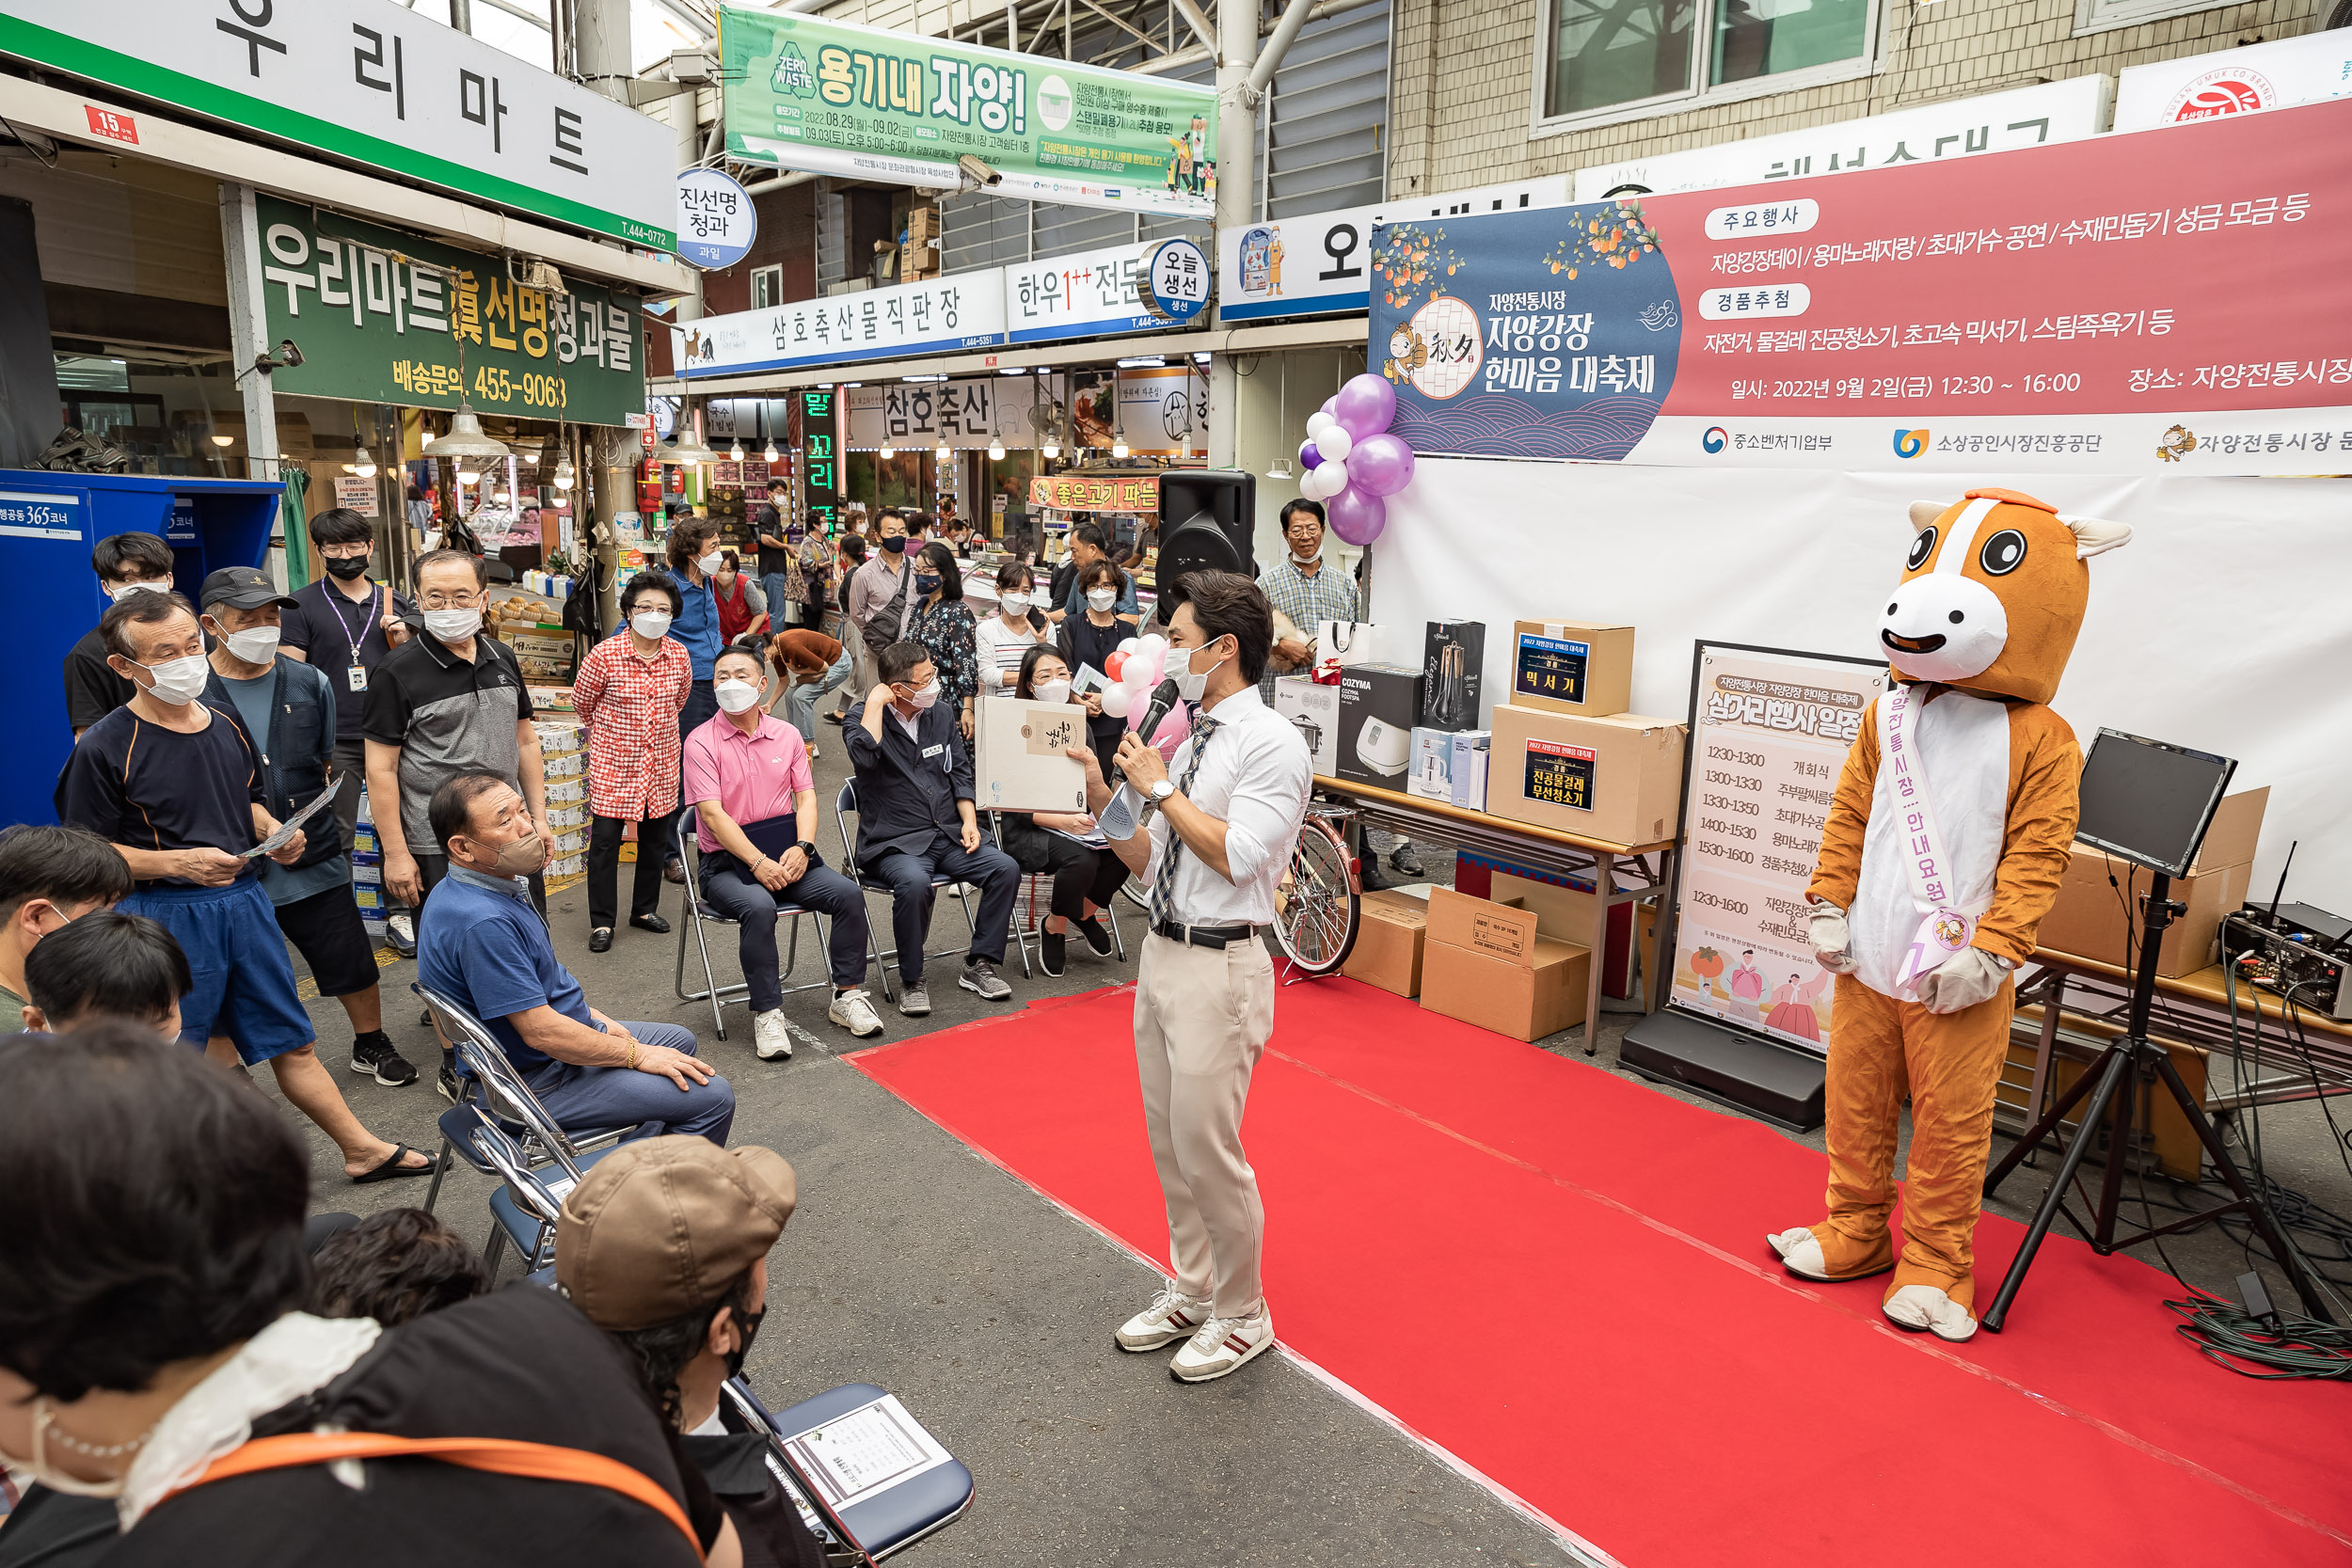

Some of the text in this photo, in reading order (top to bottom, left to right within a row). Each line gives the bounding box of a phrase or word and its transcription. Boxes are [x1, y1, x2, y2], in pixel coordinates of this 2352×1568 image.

[779, 56, 807, 73] ZERO
[216, 0, 590, 176] 우리마트
[775, 70, 813, 88] WASTE
[819, 48, 1025, 133] 용기내 자양!
[1076, 83, 1132, 101] 자양전통시장에서
[1076, 96, 1093, 108] 5만원
[1095, 98, 1110, 110] 이상
[2166, 87, 2192, 117] BUSAN
[2198, 71, 2227, 87] UMUK
[98, 112, 119, 132] 15
[776, 105, 800, 119] 응모기간
[942, 130, 988, 148] 자양전통시장
[989, 135, 1018, 150] 고객쉼터
[1020, 141, 1030, 152] 1층
[1157, 122, 1174, 135] 응모!
[805, 128, 845, 145] 09.03(토)
[847, 134, 865, 149] 오후
[867, 135, 908, 153] 5:00~6:00
[852, 158, 886, 169] 자양전통시장
[679, 187, 737, 214] 진선명
[622, 220, 666, 246] T.444-0772
[690, 214, 729, 237] 청과
[1710, 245, 1803, 275] 자양강장데이
[1813, 235, 1916, 268] 용마노래자랑
[1926, 228, 2004, 257] 초대가수
[2006, 222, 2048, 252] 공연
[2060, 209, 2169, 245] 수재민돕기
[2173, 203, 2223, 234] 성금
[2224, 198, 2279, 228] 모금
[2280, 192, 2312, 222] 등
[698, 246, 721, 261] 과일
[1165, 251, 1199, 275] 오늘
[1165, 274, 1197, 297] 생선
[1170, 300, 1188, 312] 생선
[1488, 291, 1567, 312] 자양전통시장
[772, 286, 961, 351] 삼호축산물직판장
[961, 335, 993, 348] T.444-5351
[1486, 312, 1595, 352] 자양강장
[1704, 309, 2175, 355] 자전거, 물걸레 진공청소기, 초고속 믹서기, 스팀족욕기 등
[1485, 354, 1655, 393] 한마음 대축제
[1731, 379, 1767, 401] 일시:
[1772, 378, 1831, 399] 2022년
[1836, 378, 1865, 399] 9월
[1869, 376, 1933, 399] 2일(금)
[1942, 376, 1994, 395] 12:30
[2023, 372, 2081, 393] 16:00
[2128, 368, 2183, 393] 장소:
[2191, 358, 2352, 389] 자양전통시장
[475, 365, 566, 408] 455-9063
[1735, 434, 1833, 451] 중소벤처기업부
[1936, 435, 2102, 453] 소상공인시장진흥공단
[2200, 431, 2333, 453] 자양전통시장
[1057, 483, 1157, 508] 좋은고기 파는
[26, 506, 49, 525] 365
[51, 512, 68, 525] 코너
[1535, 640, 1554, 649] 자양강장
[1555, 642, 1569, 652] 한마음
[1569, 644, 1584, 654] 대축제
[1342, 677, 1372, 690] COZYMA
[1720, 676, 1858, 705] 자양전통시장 자양강장 한마음 대축제
[1708, 691, 1817, 734] 삼거리행사
[1542, 743, 1561, 753] 자양강장
[1562, 747, 1576, 755] 한마음
[1577, 750, 1592, 758] 대축제
[1708, 746, 1829, 780] 12:30~13:00 개회식
[1534, 771, 1584, 792] 진공물걸레
[1705, 769, 1762, 792] 13:00~13:30
[1533, 784, 1582, 807] 무선청소기
[1703, 794, 1759, 816] 13:30~13:50
[1700, 817, 1756, 840] 14:00~15:30
[1698, 841, 1754, 864] 15:30~16:00
[1692, 890, 1749, 915] 12:30~16:00
[1757, 920, 1812, 945] 수재민모금
[1788, 915, 1797, 928] &
[1757, 943, 1768, 953] 따라
[1791, 955, 1815, 966] 있습니다.
